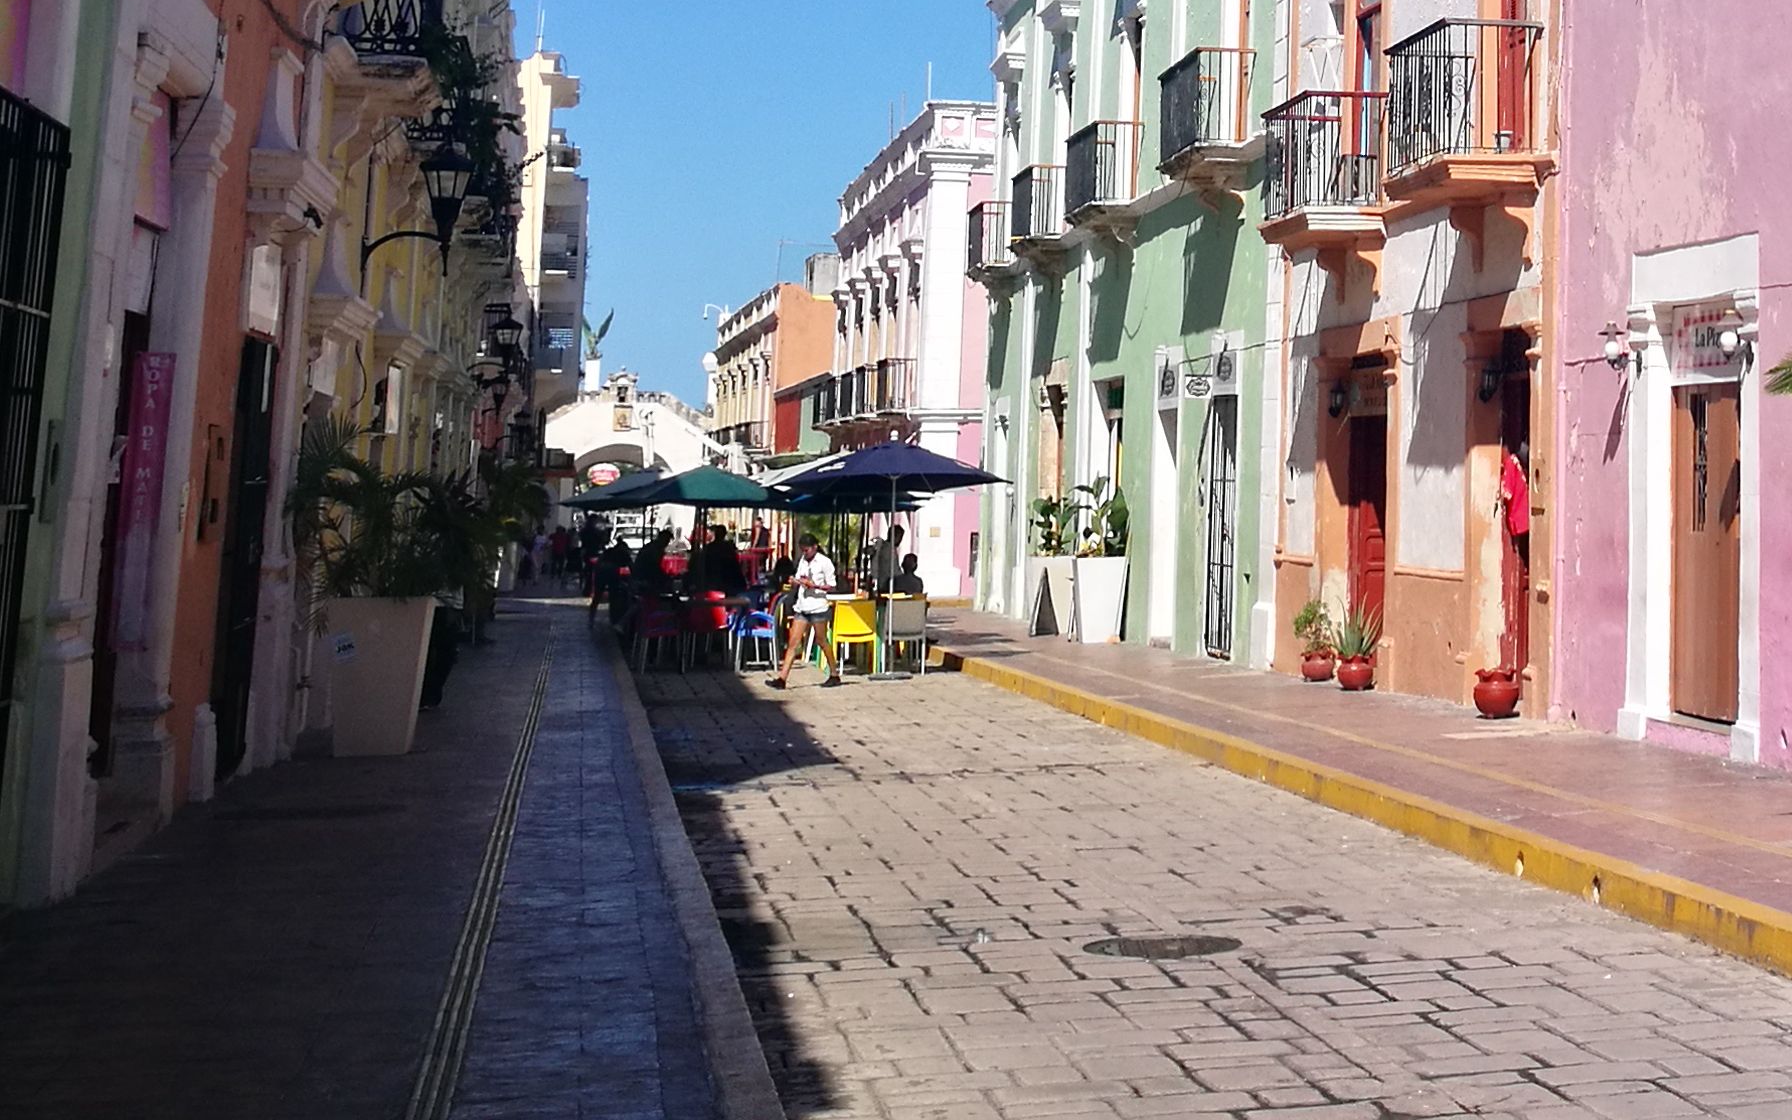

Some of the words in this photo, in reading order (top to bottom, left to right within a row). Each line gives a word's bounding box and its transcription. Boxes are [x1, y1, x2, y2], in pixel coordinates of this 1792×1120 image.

[1695, 327, 1705, 348] La
[144, 356, 162, 409] ROPA
[141, 425, 154, 451] DE
